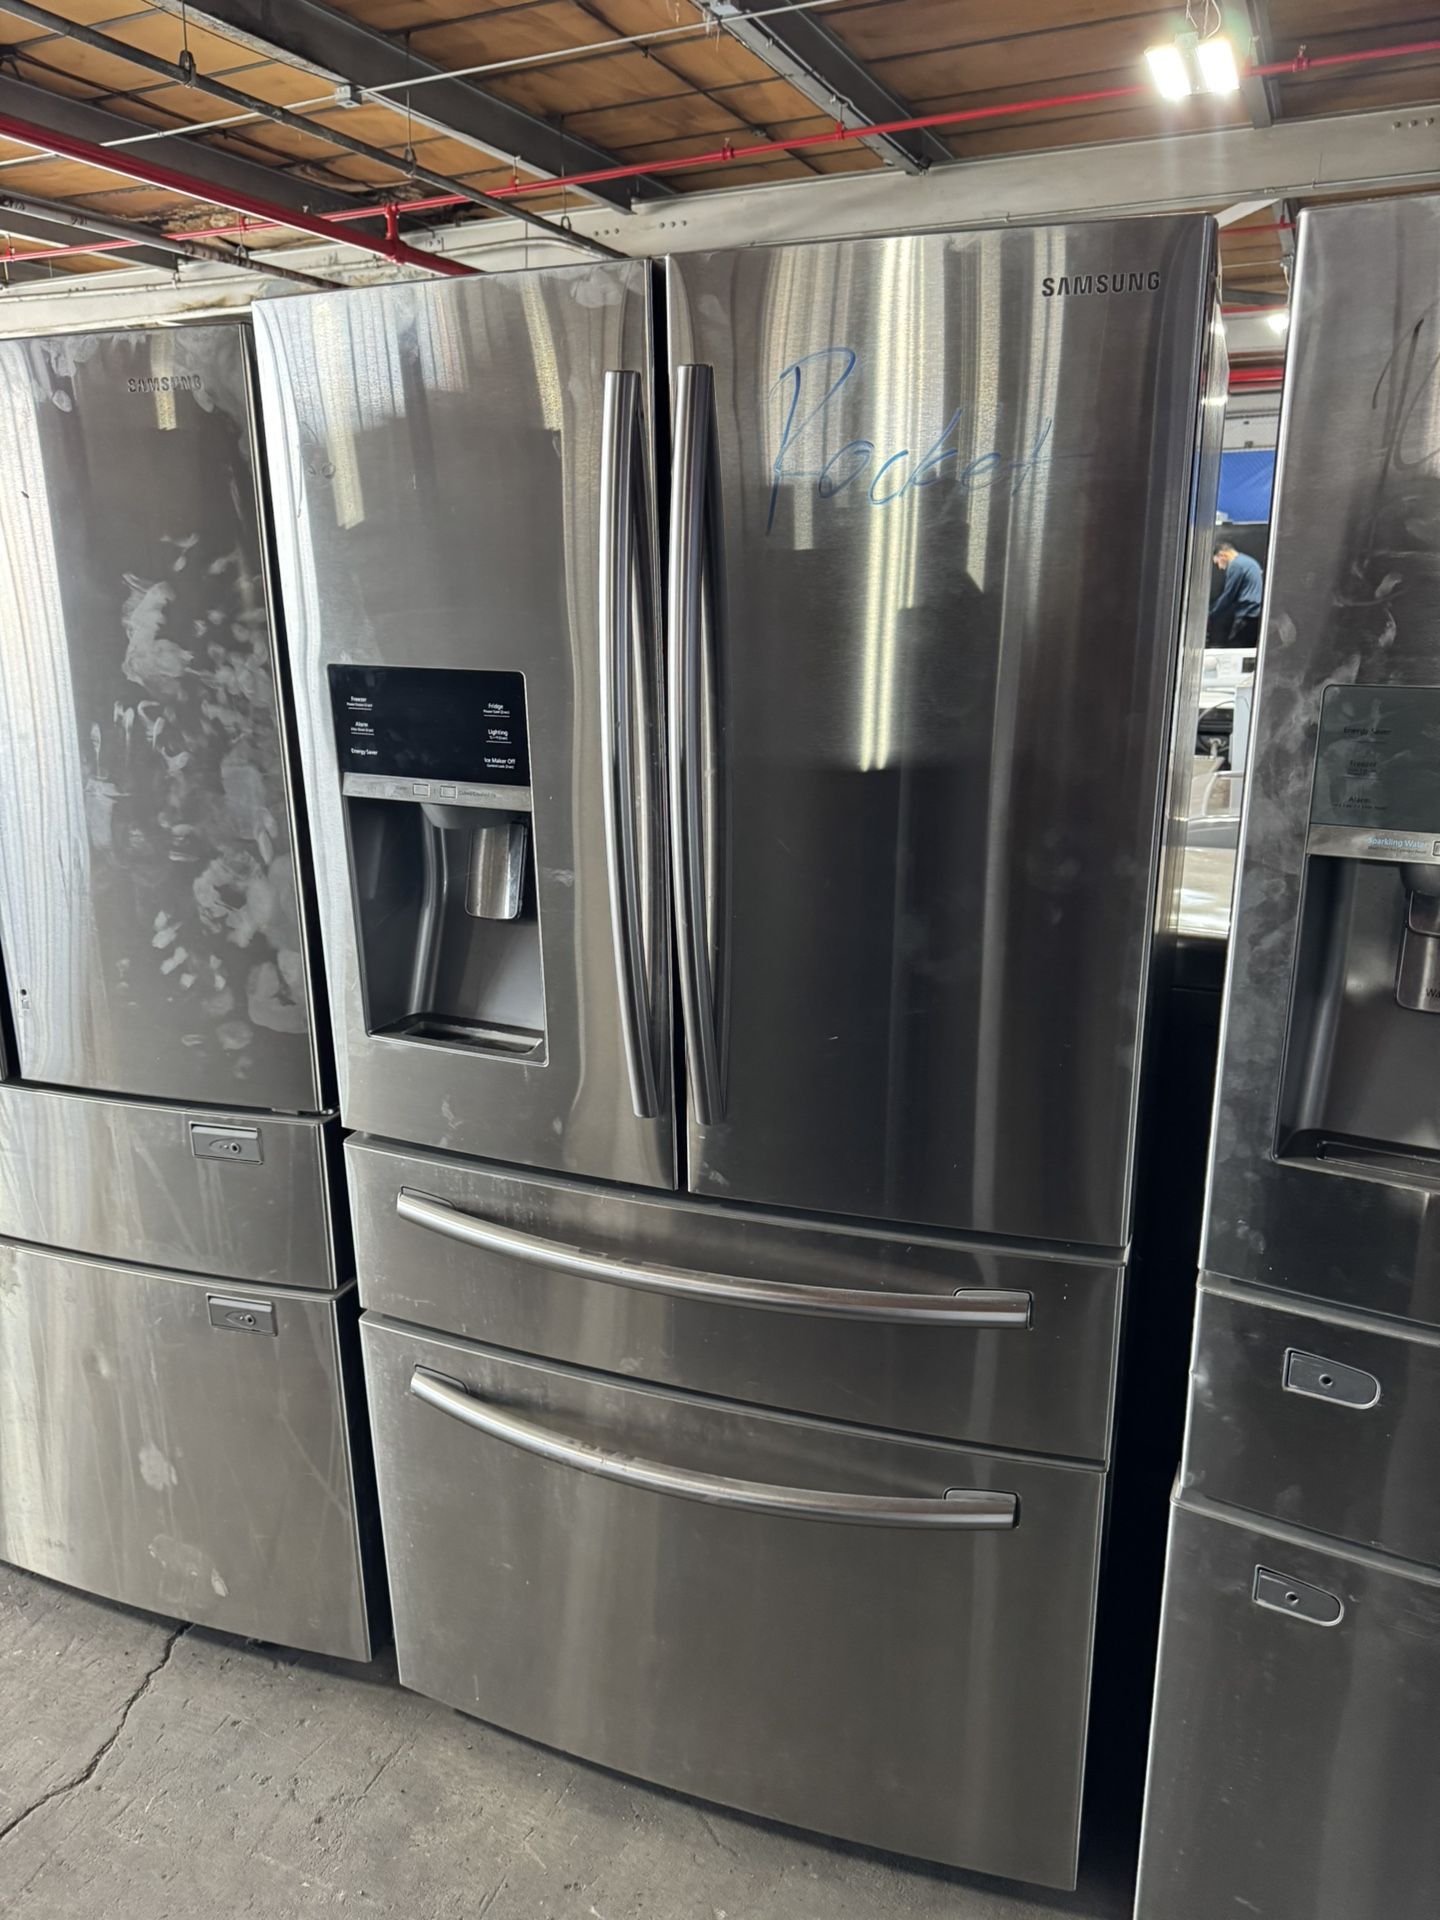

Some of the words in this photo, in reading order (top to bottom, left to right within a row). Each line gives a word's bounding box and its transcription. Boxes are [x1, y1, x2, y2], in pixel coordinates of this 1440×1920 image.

[1041, 270, 1160, 297] SAMSUNG
[127, 374, 203, 393] SAMSUNG
[1367, 837, 1404, 848] Sparkling
